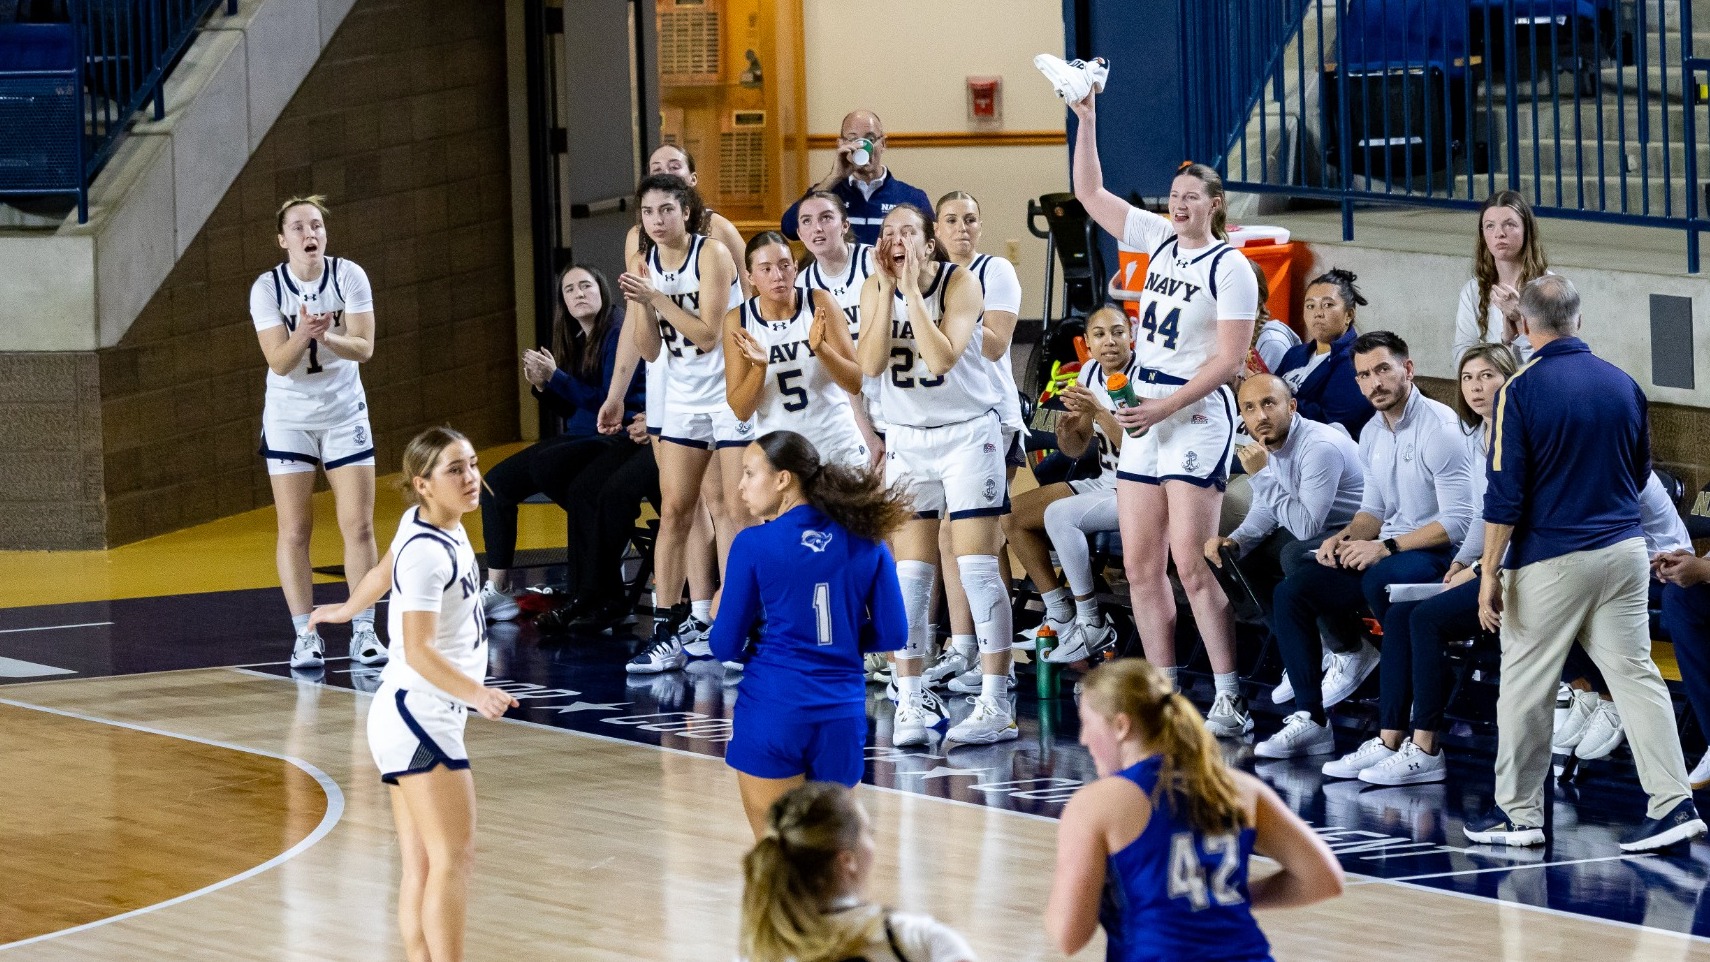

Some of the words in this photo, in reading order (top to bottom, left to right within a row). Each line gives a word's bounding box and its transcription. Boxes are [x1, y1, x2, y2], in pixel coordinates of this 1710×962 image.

[1144, 272, 1201, 302] NAVY
[1142, 300, 1181, 350] 44
[307, 336, 323, 374] 1
[768, 339, 816, 364] AVY
[776, 368, 808, 413] 5
[812, 582, 833, 646] 1
[1167, 831, 1245, 912] 42
